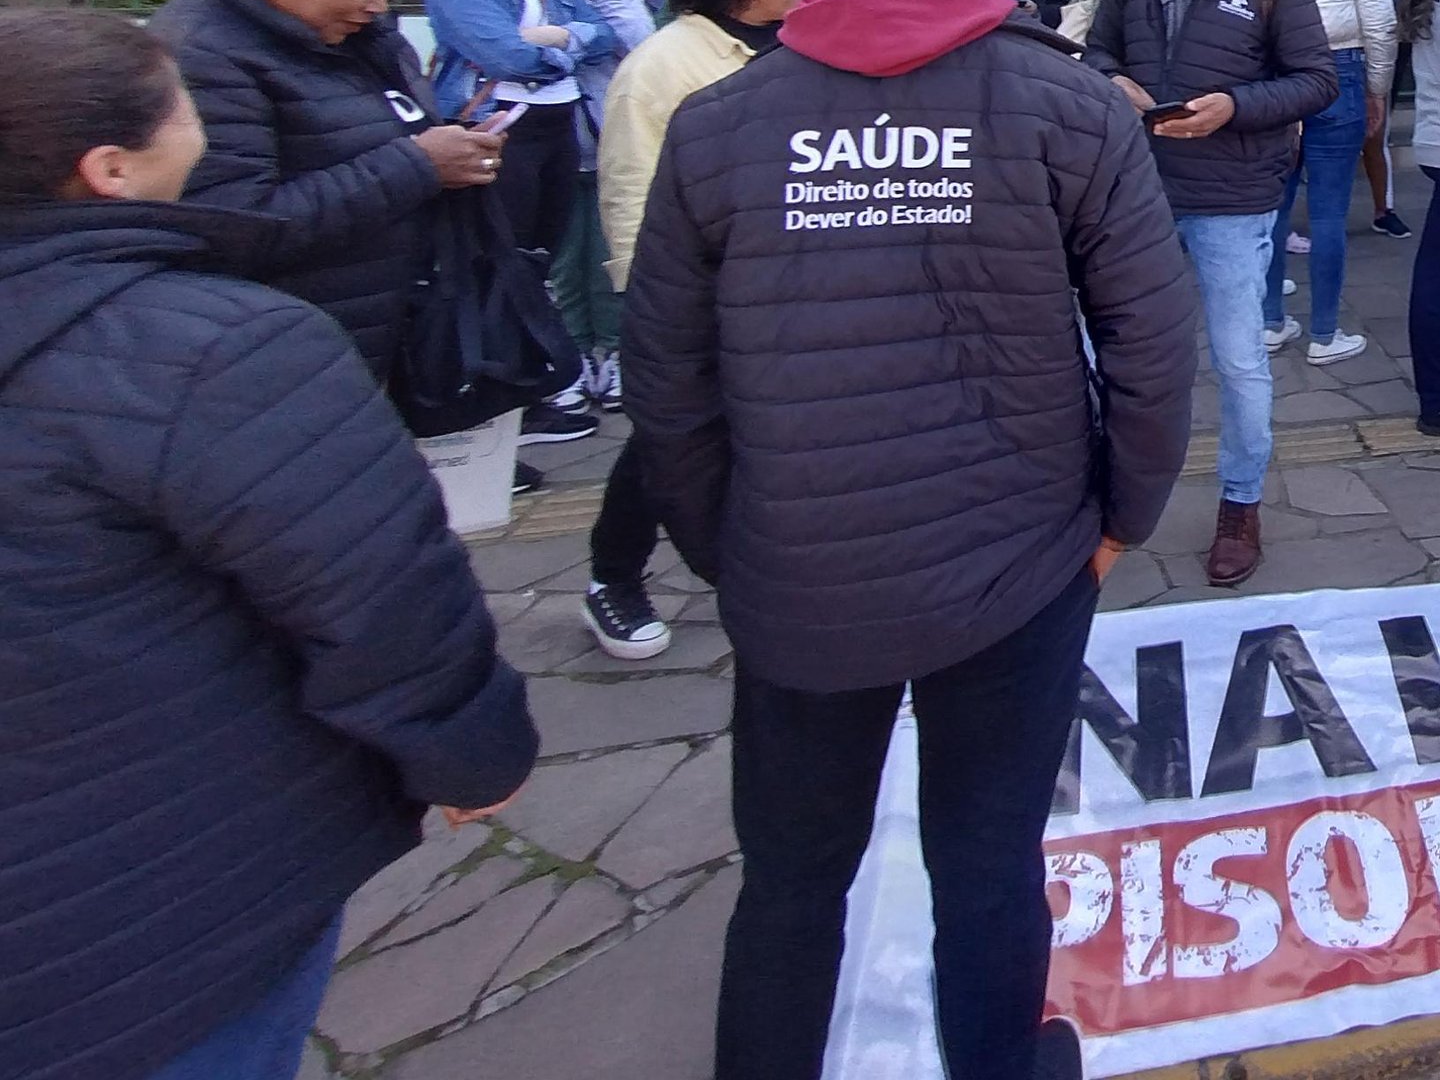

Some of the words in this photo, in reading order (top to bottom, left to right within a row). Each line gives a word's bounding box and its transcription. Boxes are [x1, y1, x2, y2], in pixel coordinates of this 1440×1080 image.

[788, 112, 973, 174] SAÚDE
[784, 179, 869, 204] Direito
[872, 178, 905, 199] de
[908, 177, 973, 199] todos
[784, 209, 855, 230] Dever
[857, 206, 888, 226] do
[891, 204, 972, 225] Estado!
[1049, 623, 1378, 814] NA
